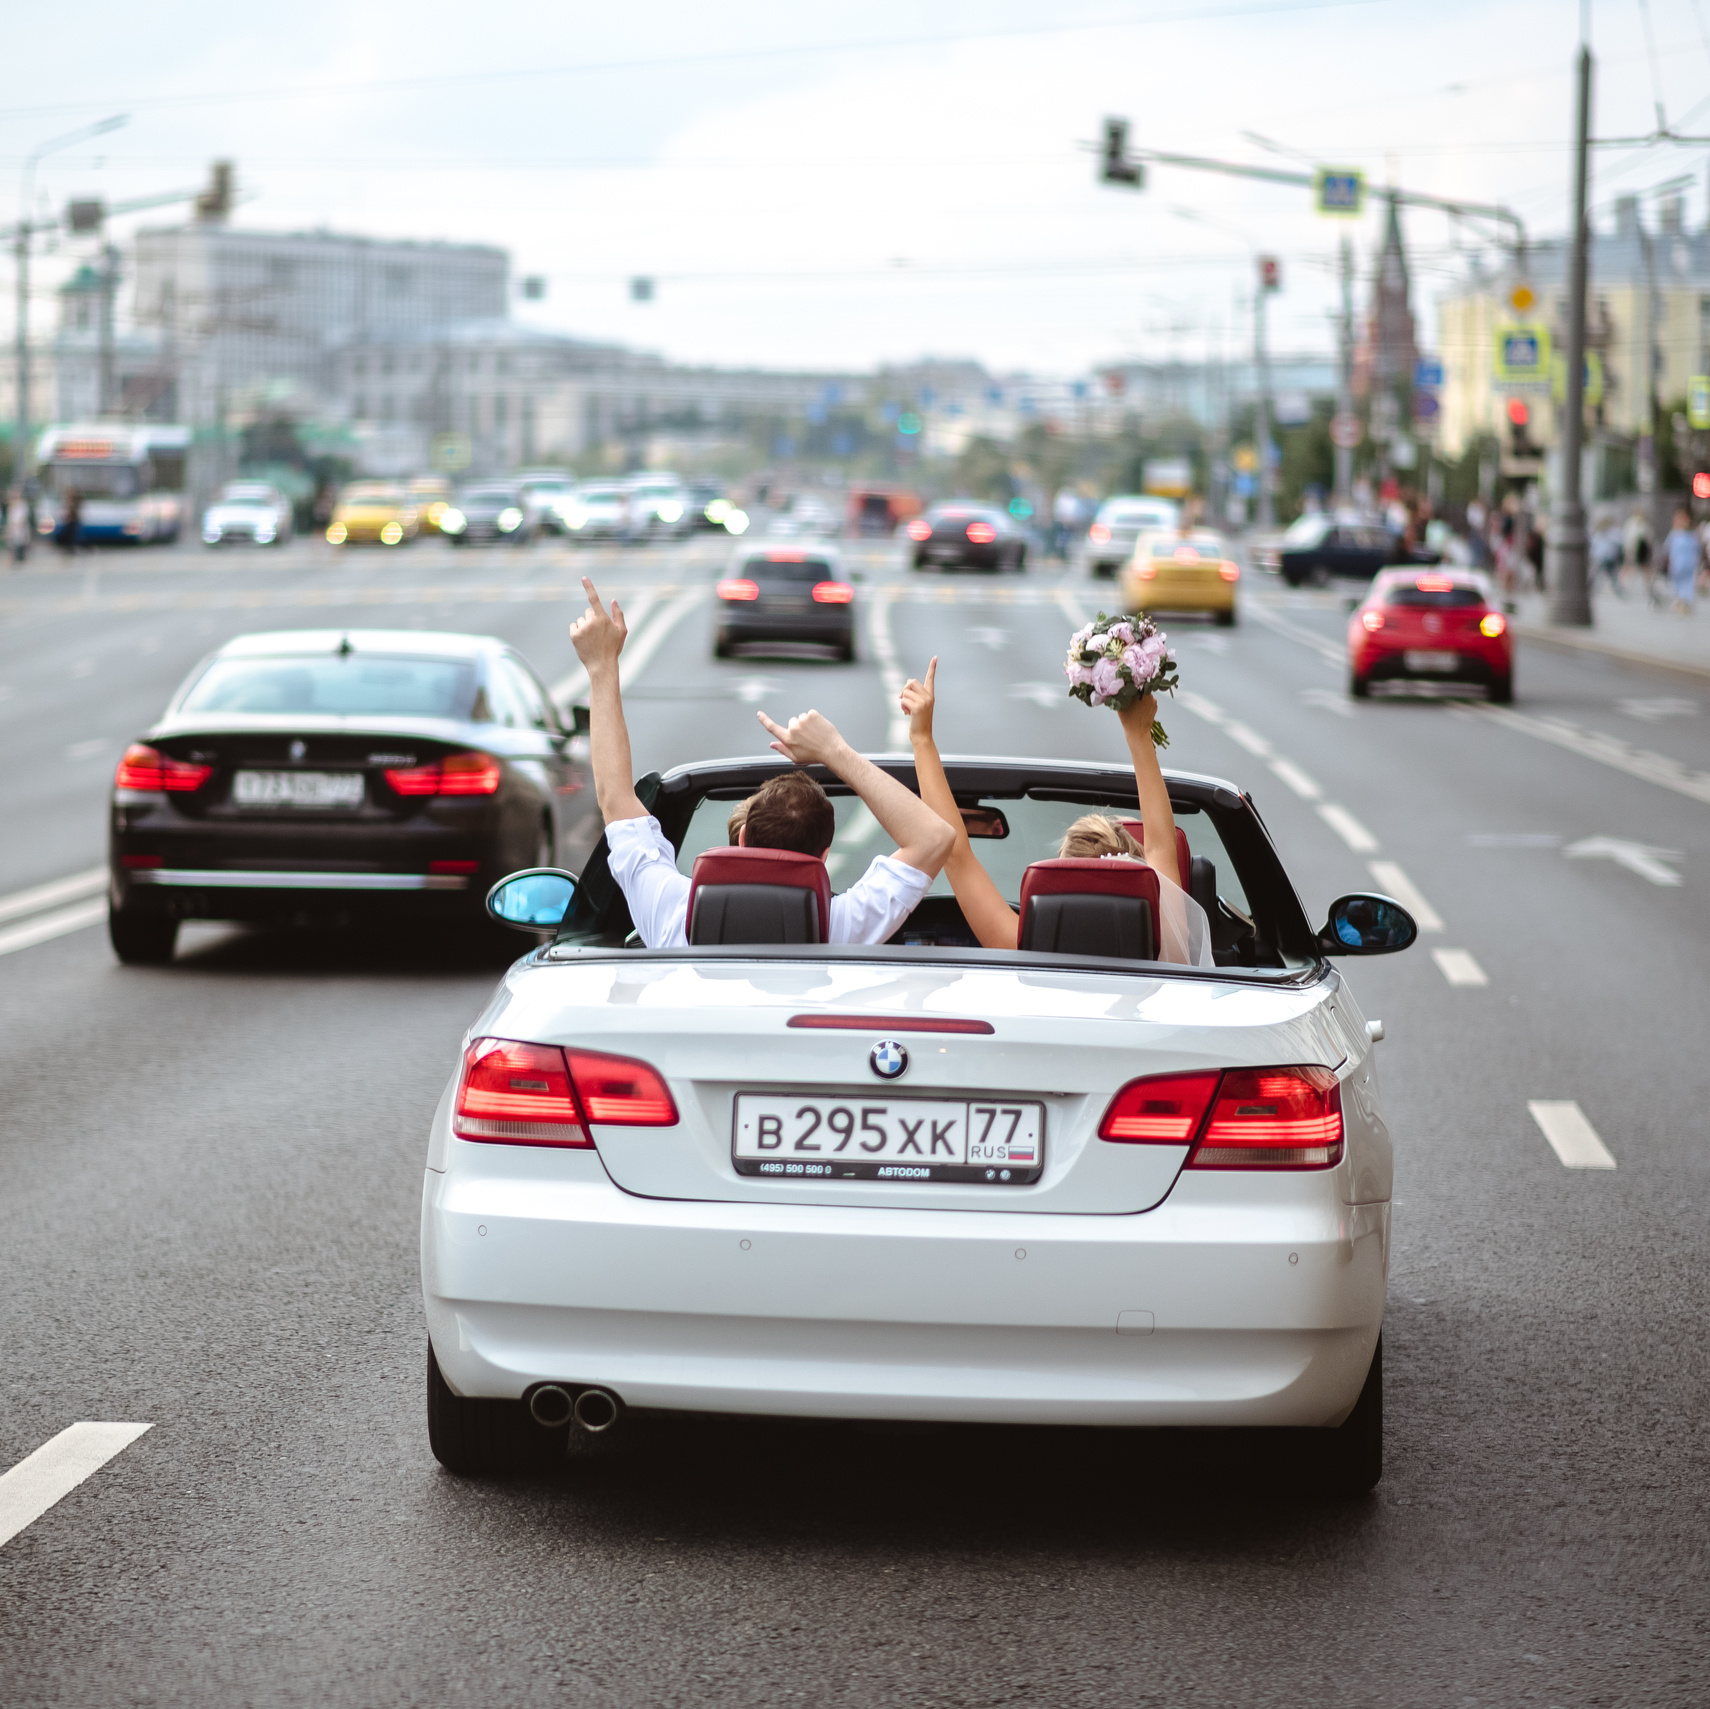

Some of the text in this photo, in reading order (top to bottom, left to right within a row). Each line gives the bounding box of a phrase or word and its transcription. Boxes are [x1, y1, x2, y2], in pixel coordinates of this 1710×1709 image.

[975, 1108, 1022, 1144] 77
[971, 1145, 1006, 1159] RUS
[760, 1163, 784, 1173] (495)
[786, 1164, 804, 1174] 500
[805, 1164, 823, 1174] 500
